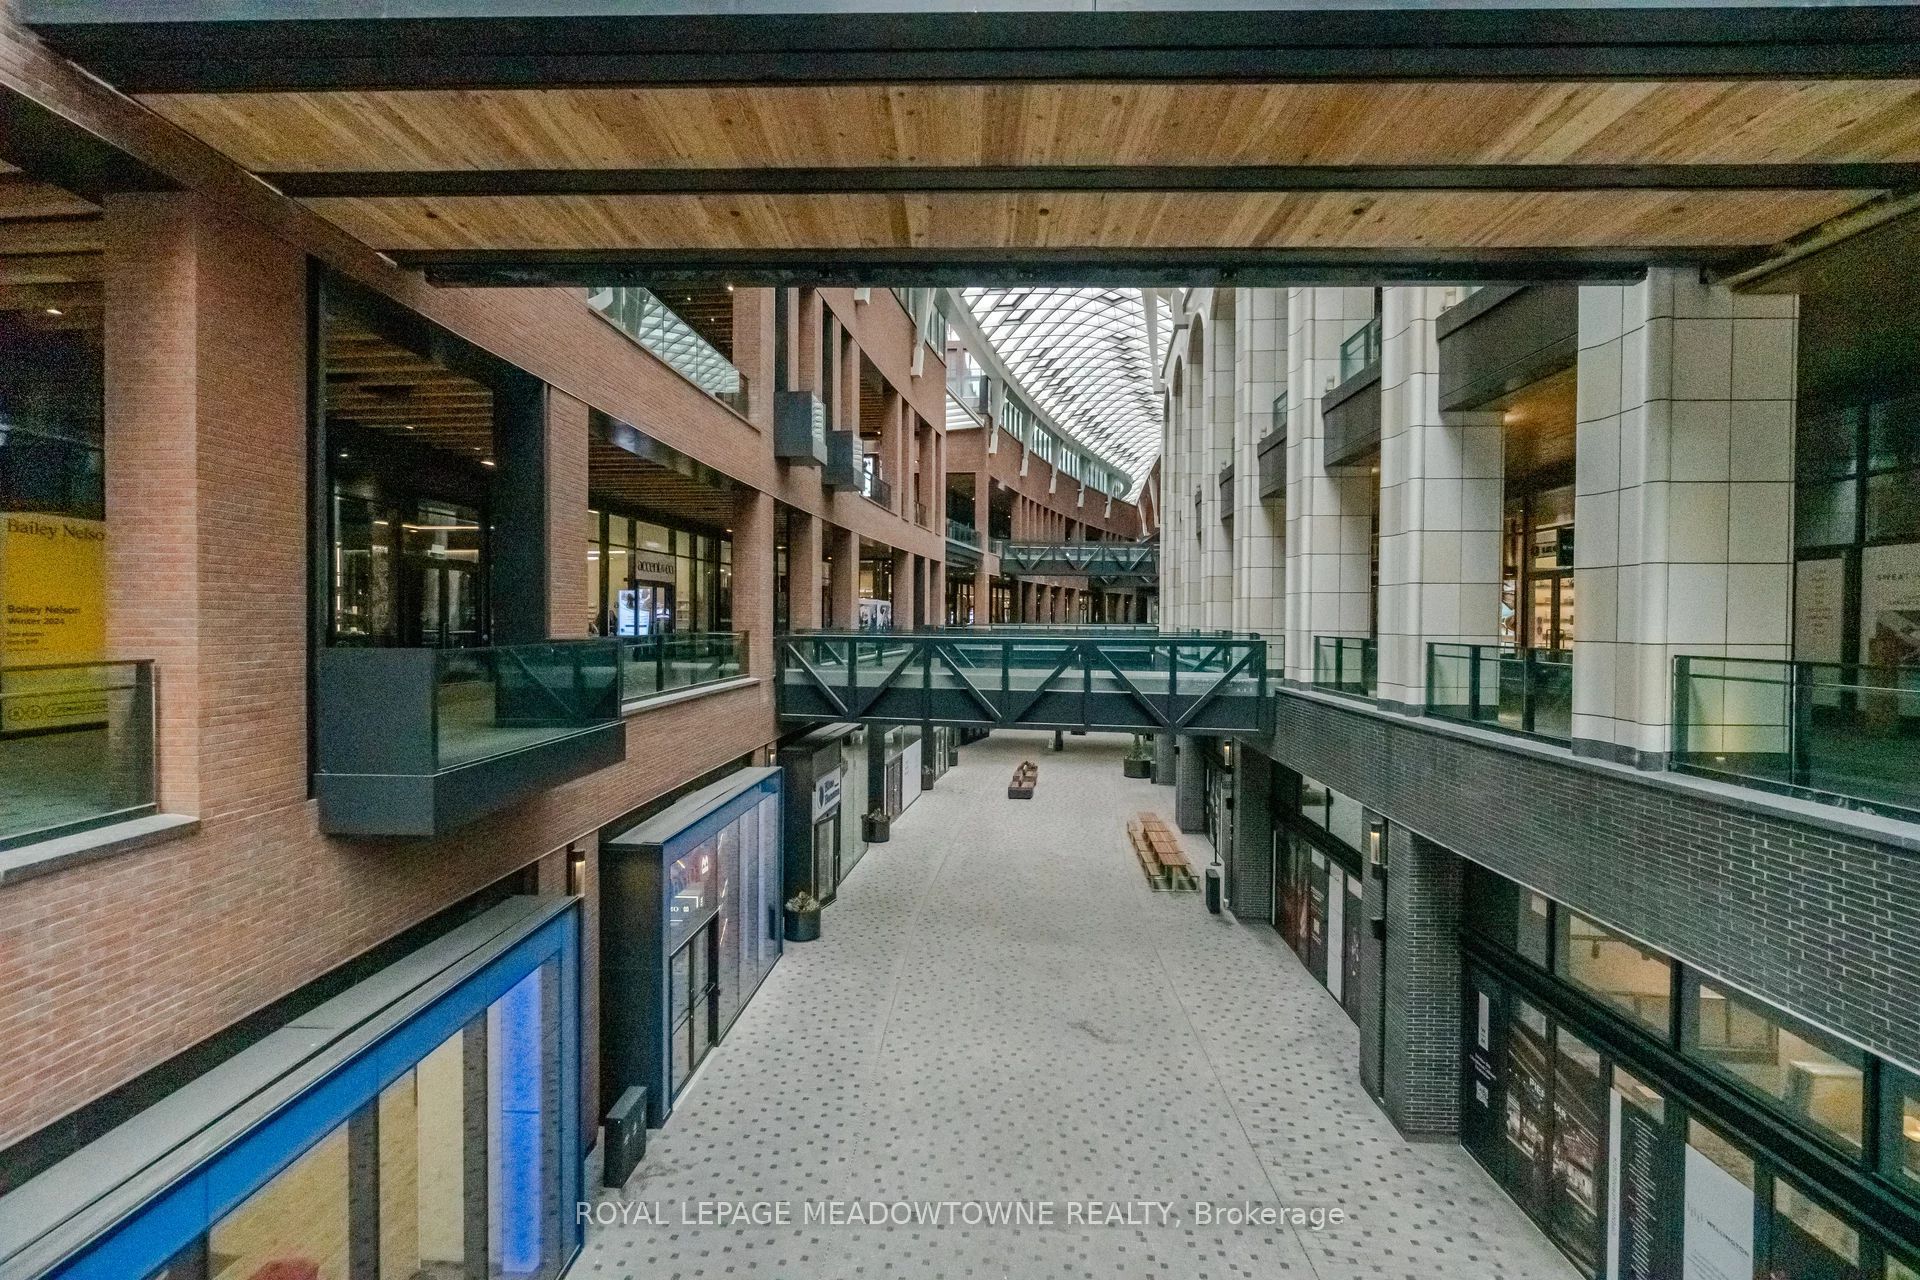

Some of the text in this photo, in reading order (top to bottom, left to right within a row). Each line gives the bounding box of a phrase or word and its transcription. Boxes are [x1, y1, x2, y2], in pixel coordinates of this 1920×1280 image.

[7, 517, 57, 540] Bailey
[7, 604, 80, 615] Bailey Nelson
